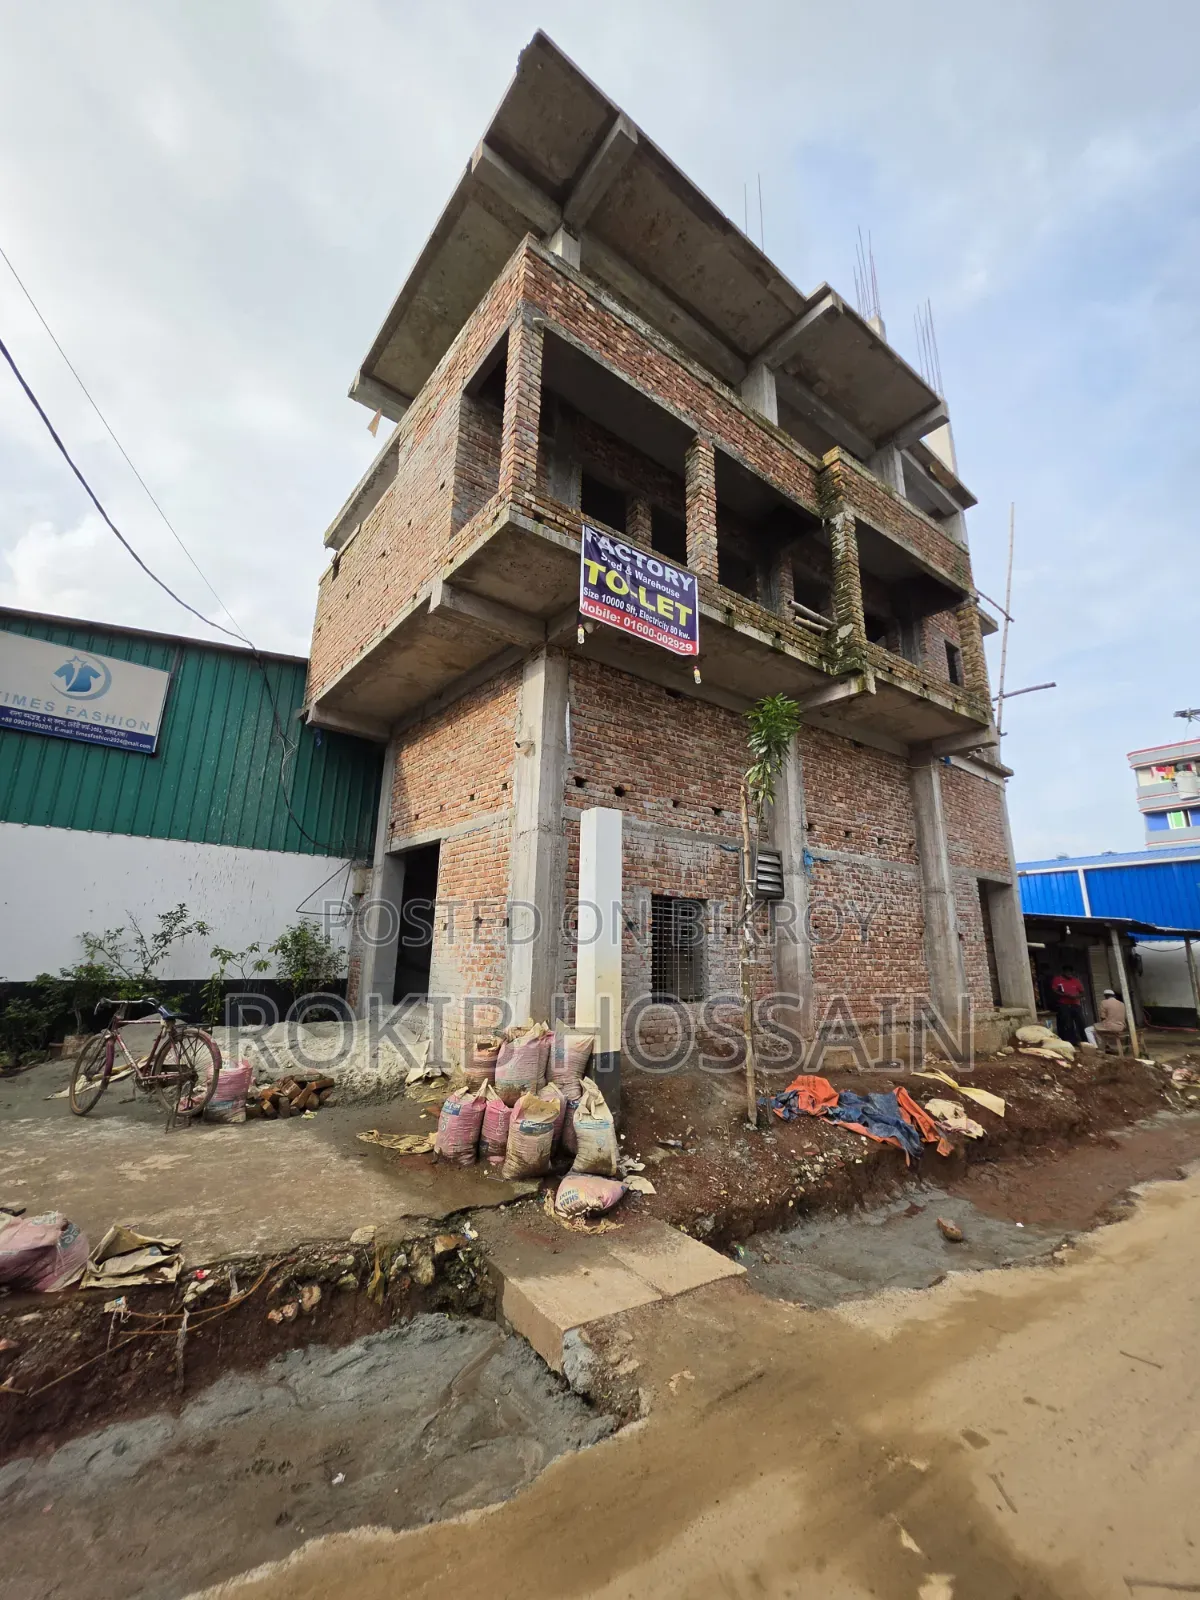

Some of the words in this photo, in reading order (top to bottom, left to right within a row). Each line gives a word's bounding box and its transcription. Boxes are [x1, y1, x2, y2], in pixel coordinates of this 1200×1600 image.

[585, 526, 693, 592] FACTORY
[600, 551, 623, 572] Sed
[625, 564, 633, 576] &
[634, 569, 680, 599] Warehouse
[583, 586, 600, 600] Size
[601, 594, 625, 610] 10000
[626, 603, 638, 618] Sft,
[639, 609, 670, 633] Electricity
[584, 557, 693, 627] TO-LET
[581, 600, 621, 623] Mobile:
[623, 616, 694, 652] 01600-002929
[66, 704, 150, 732] FASHION
